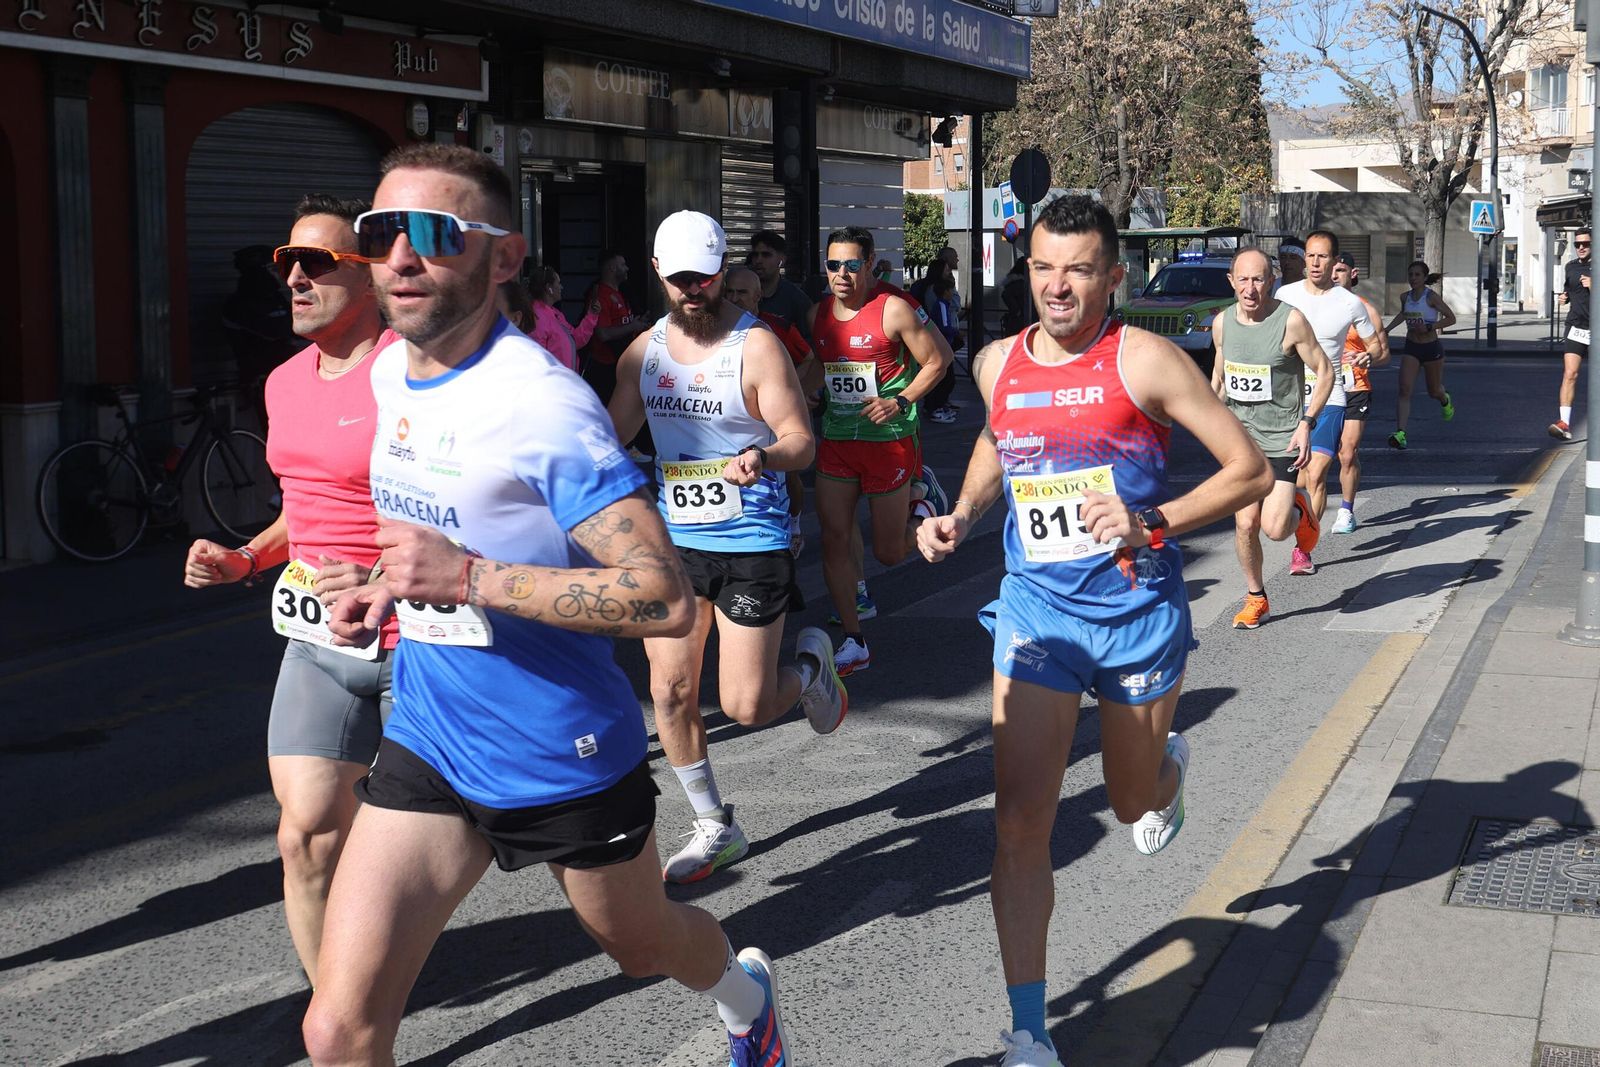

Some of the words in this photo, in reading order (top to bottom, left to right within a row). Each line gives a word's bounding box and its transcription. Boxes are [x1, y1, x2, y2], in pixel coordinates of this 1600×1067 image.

[894, 0, 915, 36] de
[922, 11, 936, 42] la
[941, 11, 981, 53] Salud
[393, 40, 439, 77] Pub
[594, 60, 671, 100] COFFEE
[831, 377, 867, 393] 550
[1230, 375, 1263, 392] 832
[645, 395, 723, 415] MARACENA
[1054, 386, 1104, 406] SEUR
[678, 413, 712, 422] ATLETISMO
[669, 466, 679, 477] 38
[395, 481, 436, 499] ATLETISMO
[672, 482, 726, 508] 633
[1022, 482, 1034, 497] 38
[277, 587, 330, 625] 30
[1118, 671, 1163, 688] SEUR
